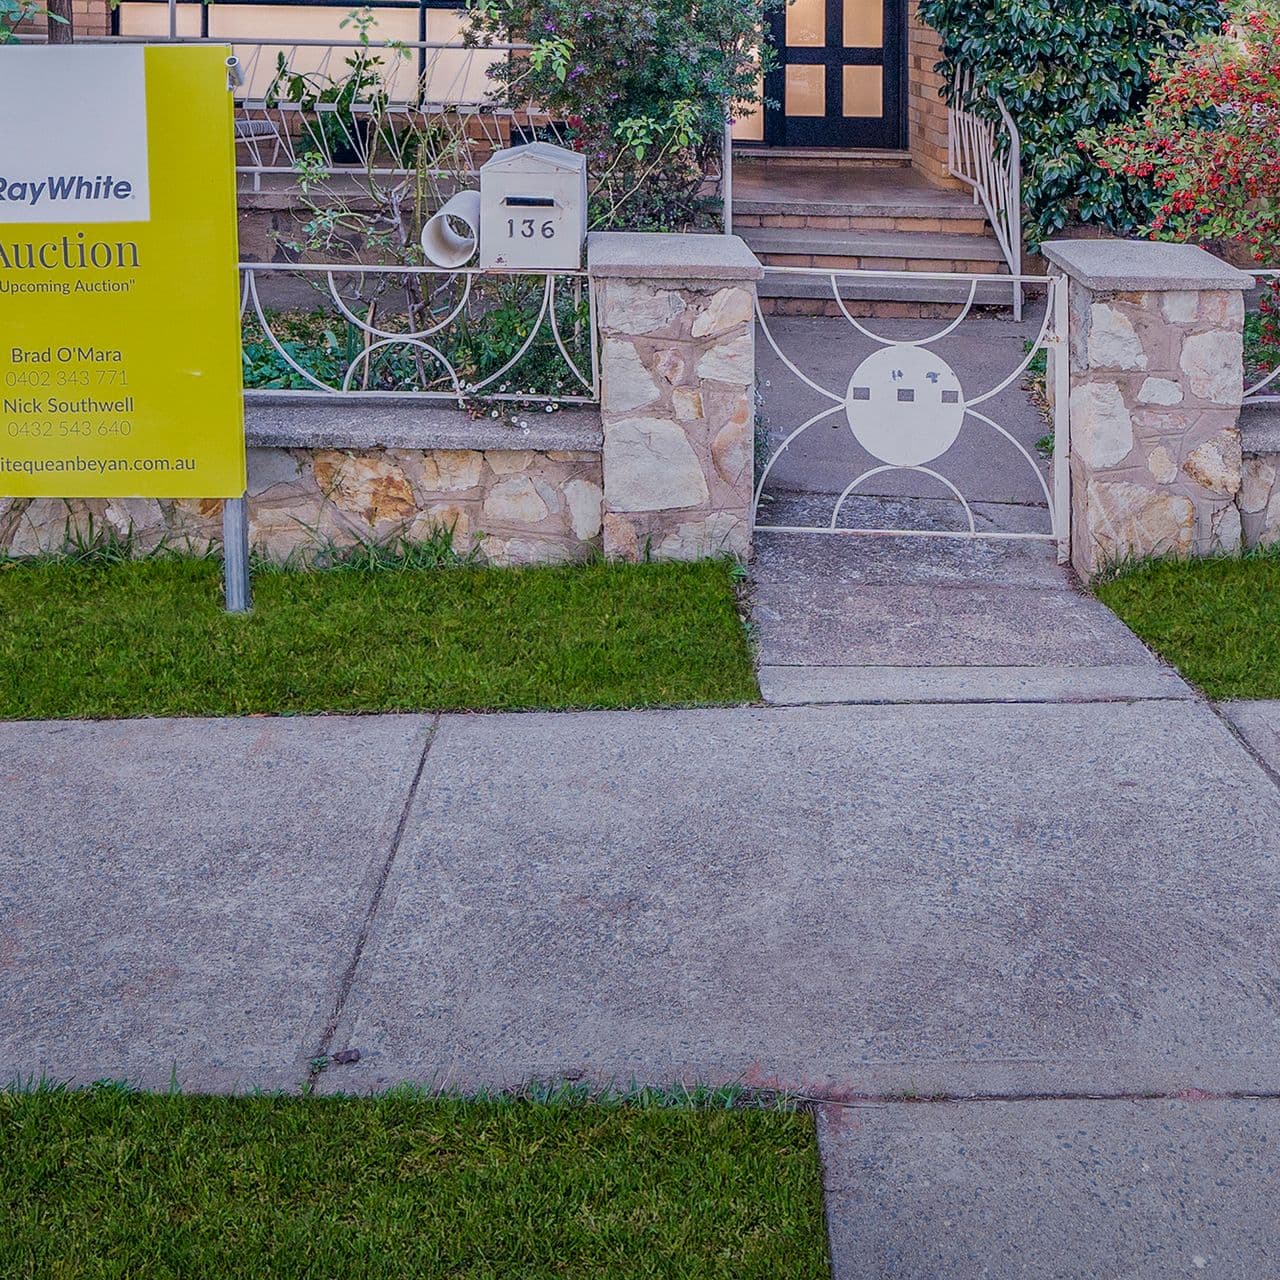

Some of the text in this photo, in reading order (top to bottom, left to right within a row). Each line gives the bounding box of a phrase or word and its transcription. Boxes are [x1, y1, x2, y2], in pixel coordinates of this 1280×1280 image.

[507, 219, 555, 238] 136
[74, 279, 136, 293] Auction"
[11, 347, 122, 363] Brad O'Mara
[5, 370, 128, 387] 0402 343 771
[3, 397, 134, 413] Nick Southwell
[7, 420, 131, 437] 0432 543 640
